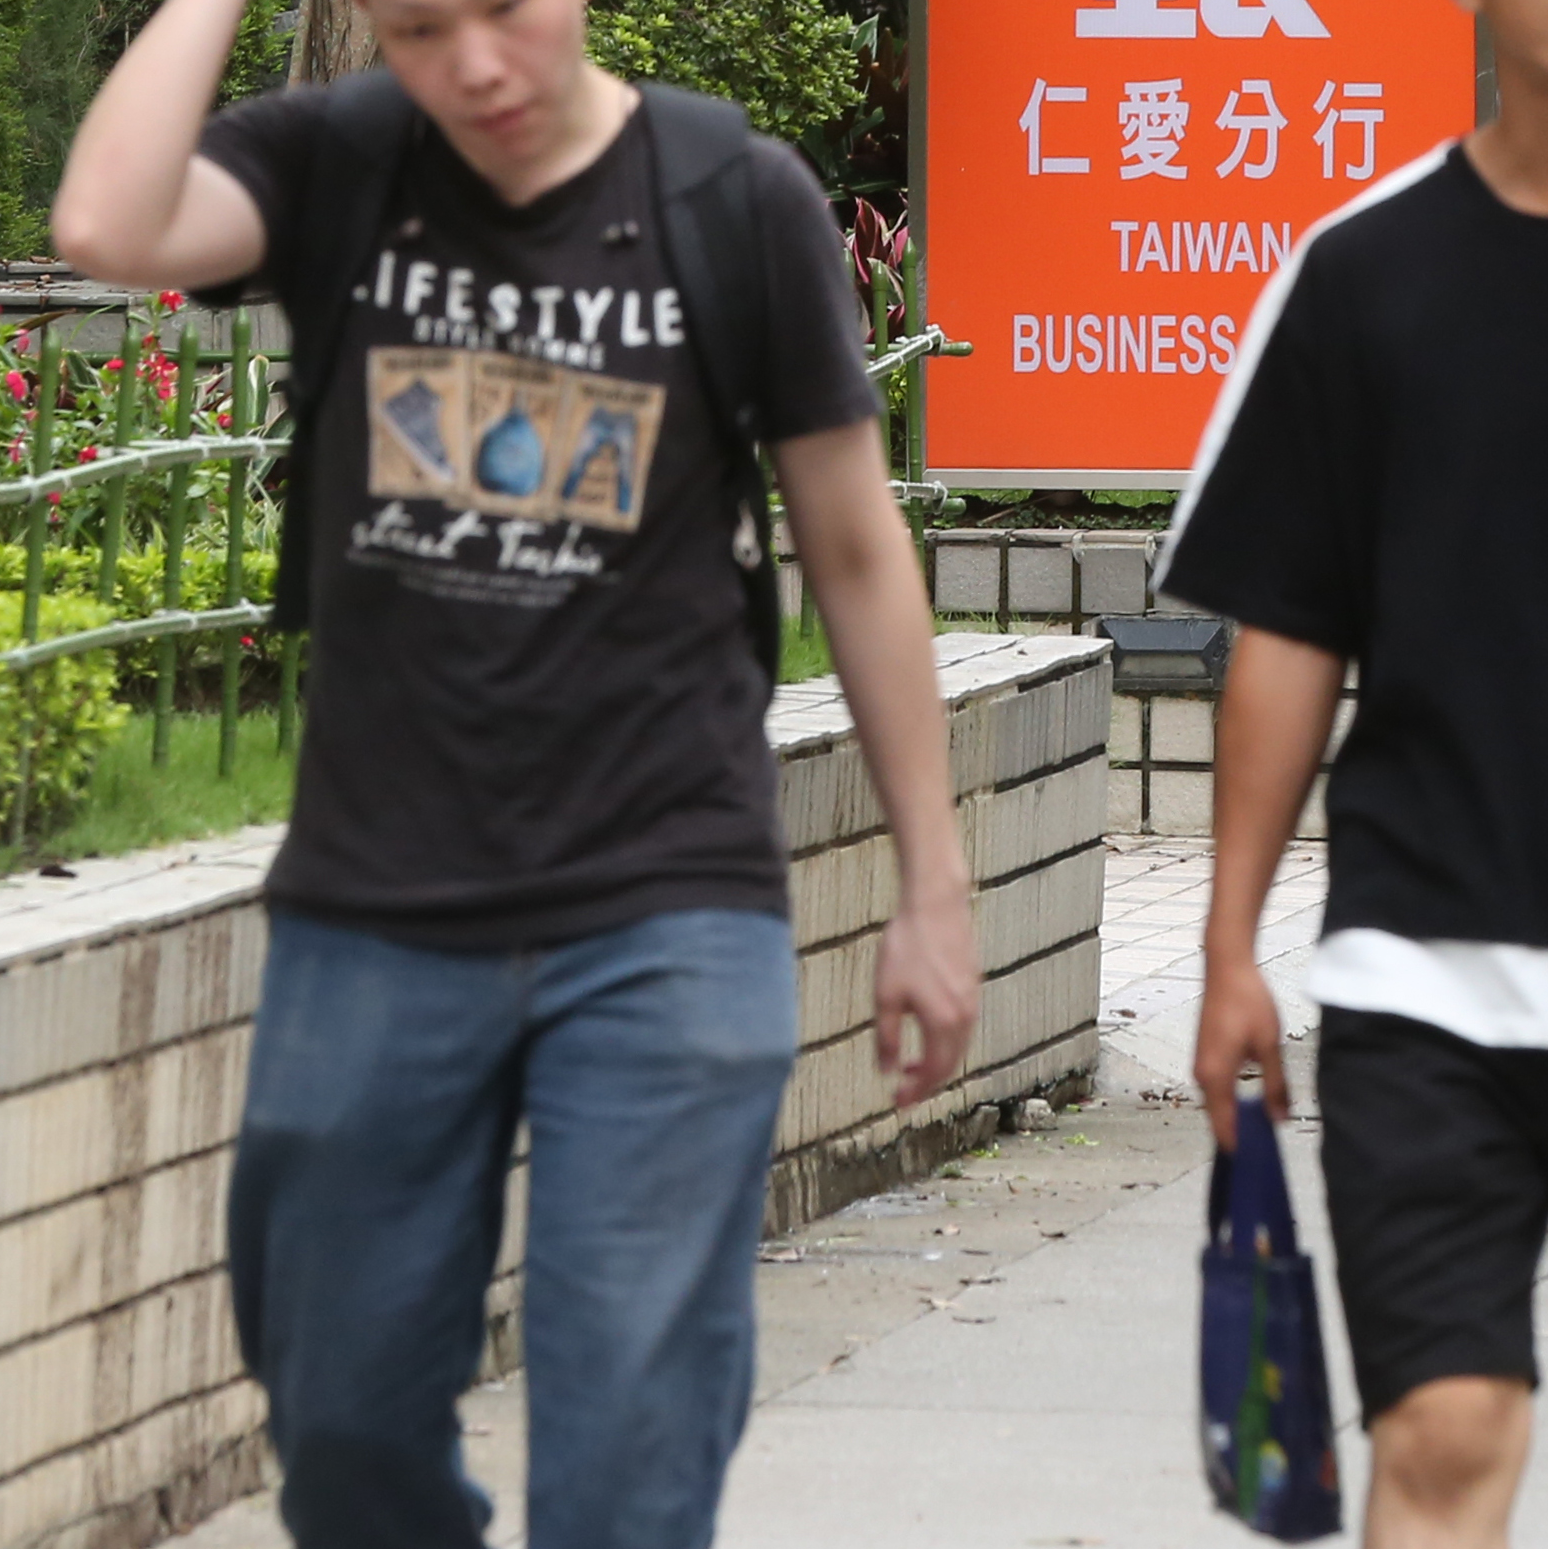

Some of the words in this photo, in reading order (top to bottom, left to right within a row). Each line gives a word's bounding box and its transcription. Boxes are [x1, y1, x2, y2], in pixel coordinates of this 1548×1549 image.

[1018, 77, 1385, 181] 仁愛分行
[1110, 221, 1293, 273] TAIWAN
[353, 250, 685, 348] IFESTYLE
[1012, 314, 1238, 375] BUSINESS
